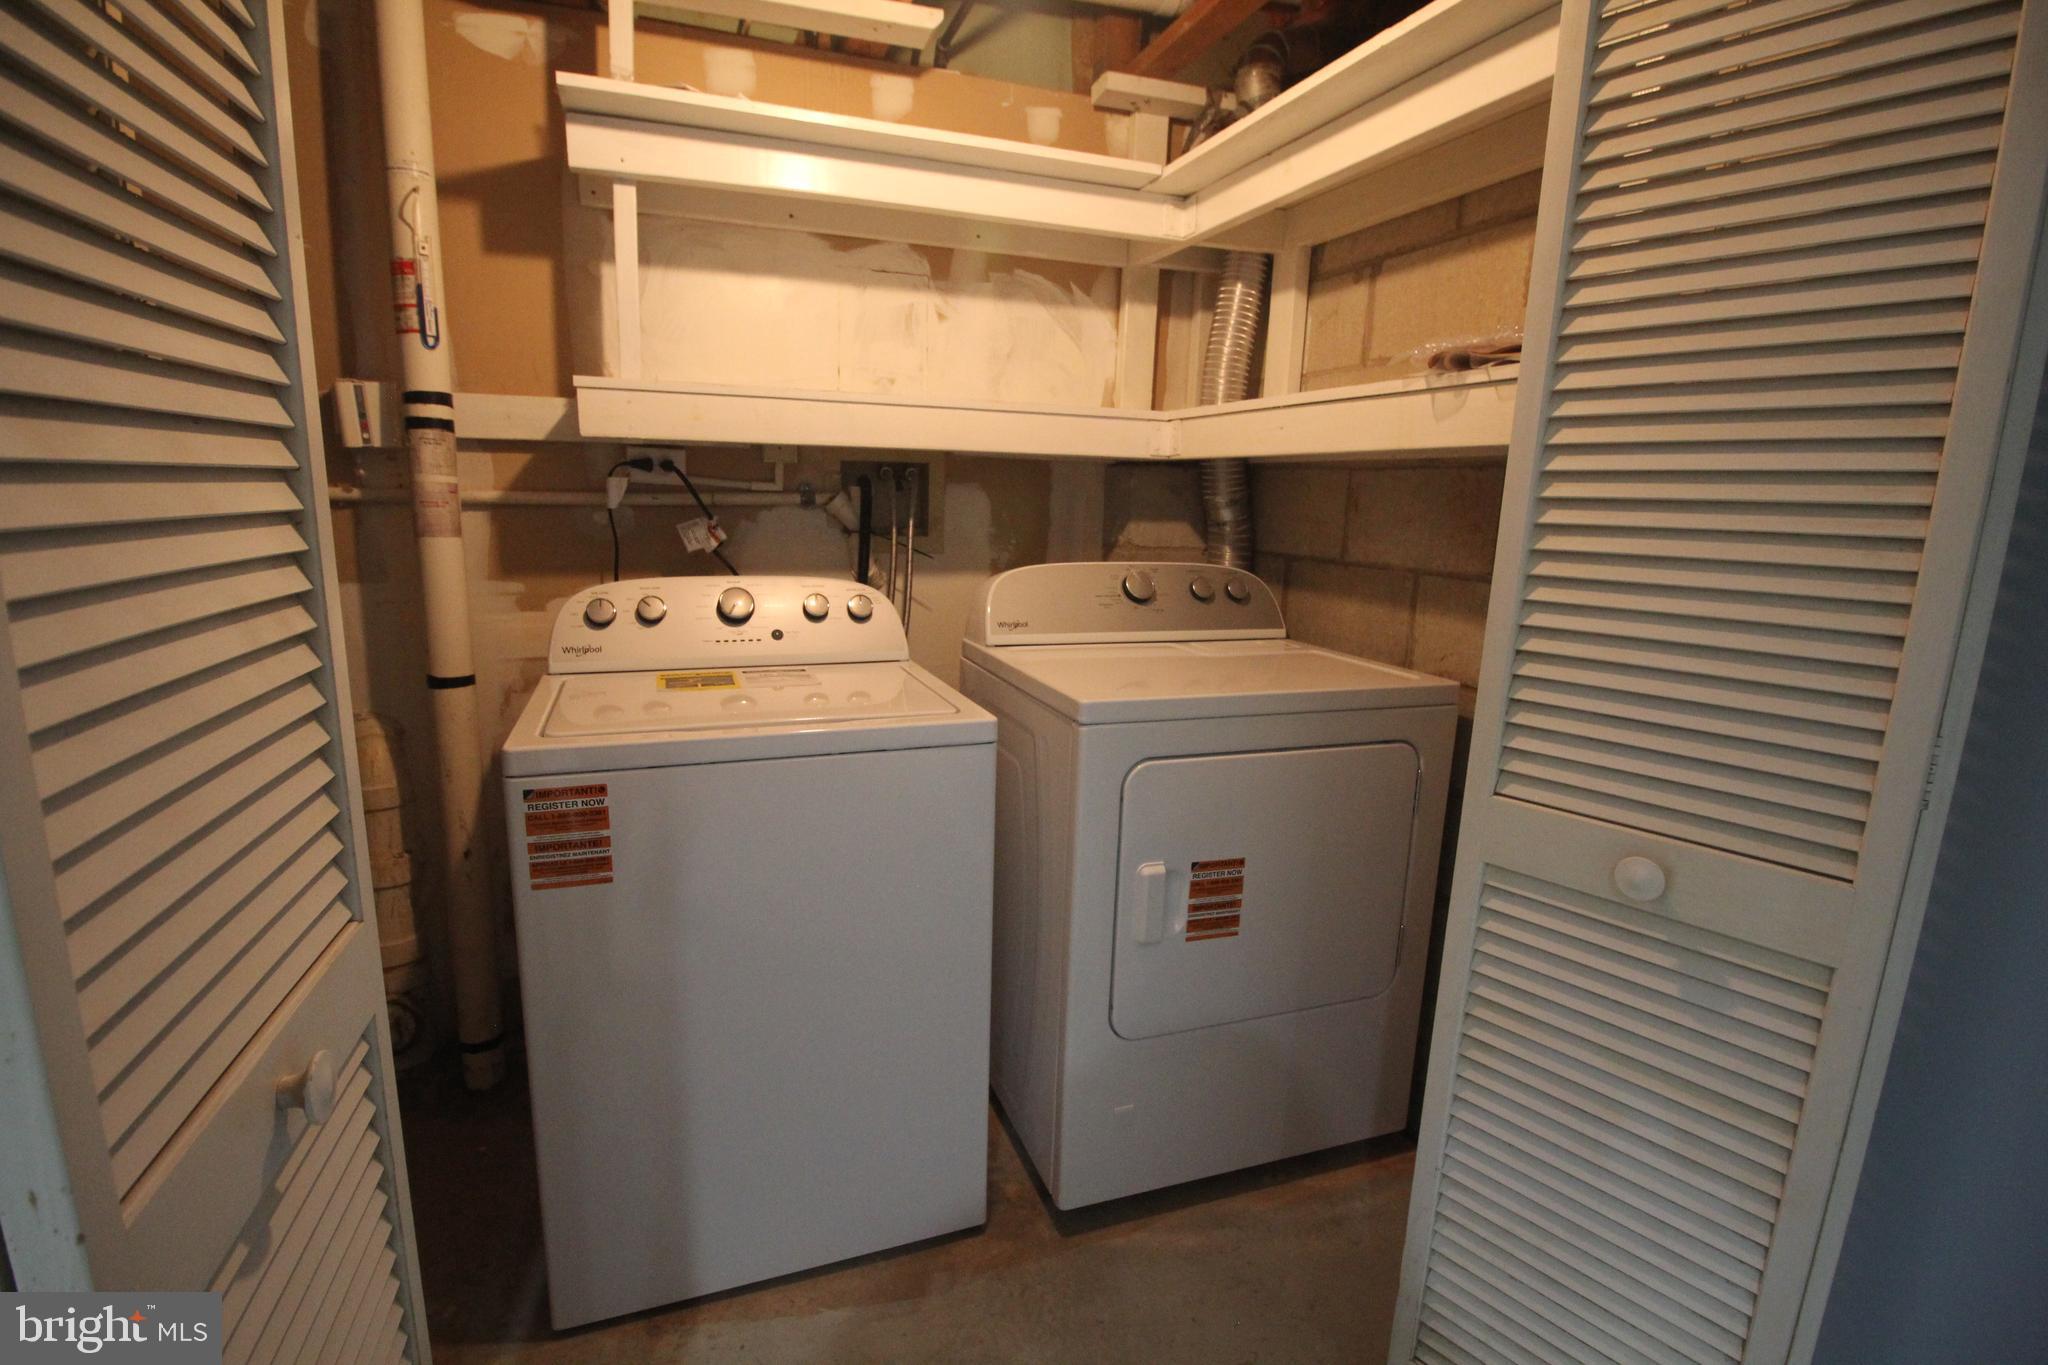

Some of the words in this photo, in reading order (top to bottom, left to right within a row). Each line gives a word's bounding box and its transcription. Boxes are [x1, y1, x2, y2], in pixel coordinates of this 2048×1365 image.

[561, 645, 602, 657] Whirlpool
[527, 800, 579, 811] REGISTER
[581, 798, 606, 807] NOW
[1192, 871, 1225, 880] REGISTER
[1226, 869, 1243, 877] NOW
